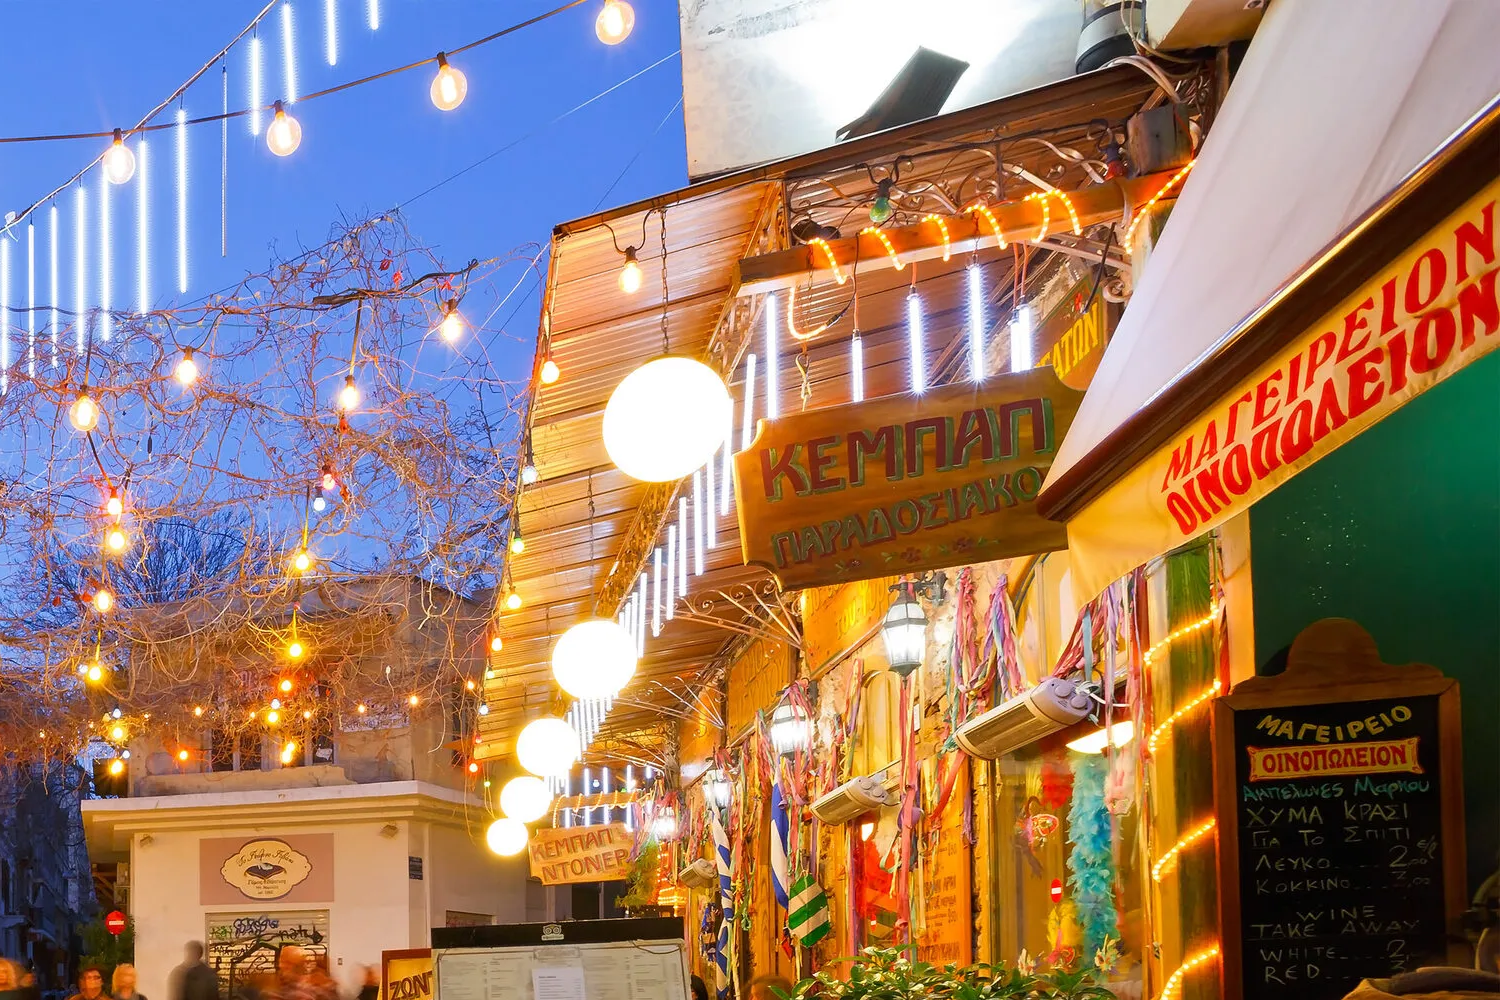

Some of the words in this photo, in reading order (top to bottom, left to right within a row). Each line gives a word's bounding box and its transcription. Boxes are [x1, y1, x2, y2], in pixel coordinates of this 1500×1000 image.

[1161, 200, 1496, 493] ΜΑΓΕΙΡΕΙΟΝ
[1167, 268, 1500, 536] ΟΙΝΟΠΩΛΕΙΟΝ
[760, 398, 1055, 502] ΚΕΜΠΑΠ
[1256, 705, 1412, 743] ΜΑΓΕΙΡΕΙΟ
[1262, 744, 1408, 773] ΟΙΝΟΠΩΛΕΙΟΝ
[1246, 806, 1324, 826] ΧΥΜΑ
[1344, 800, 1408, 822] ΚΡΑΣΙ
[531, 829, 613, 861] ΚΕΜΠΑΠ
[542, 848, 629, 881] ΝΤΟΝΕΡ
[1256, 877, 1350, 895] ΚΟΚΚΙΝΟ
[1296, 905, 1376, 921] WINE
[1251, 923, 1318, 938] TAKE
[1341, 920, 1420, 935] AWAY
[1260, 946, 1336, 962] WHITE
[1264, 964, 1321, 985] RED
